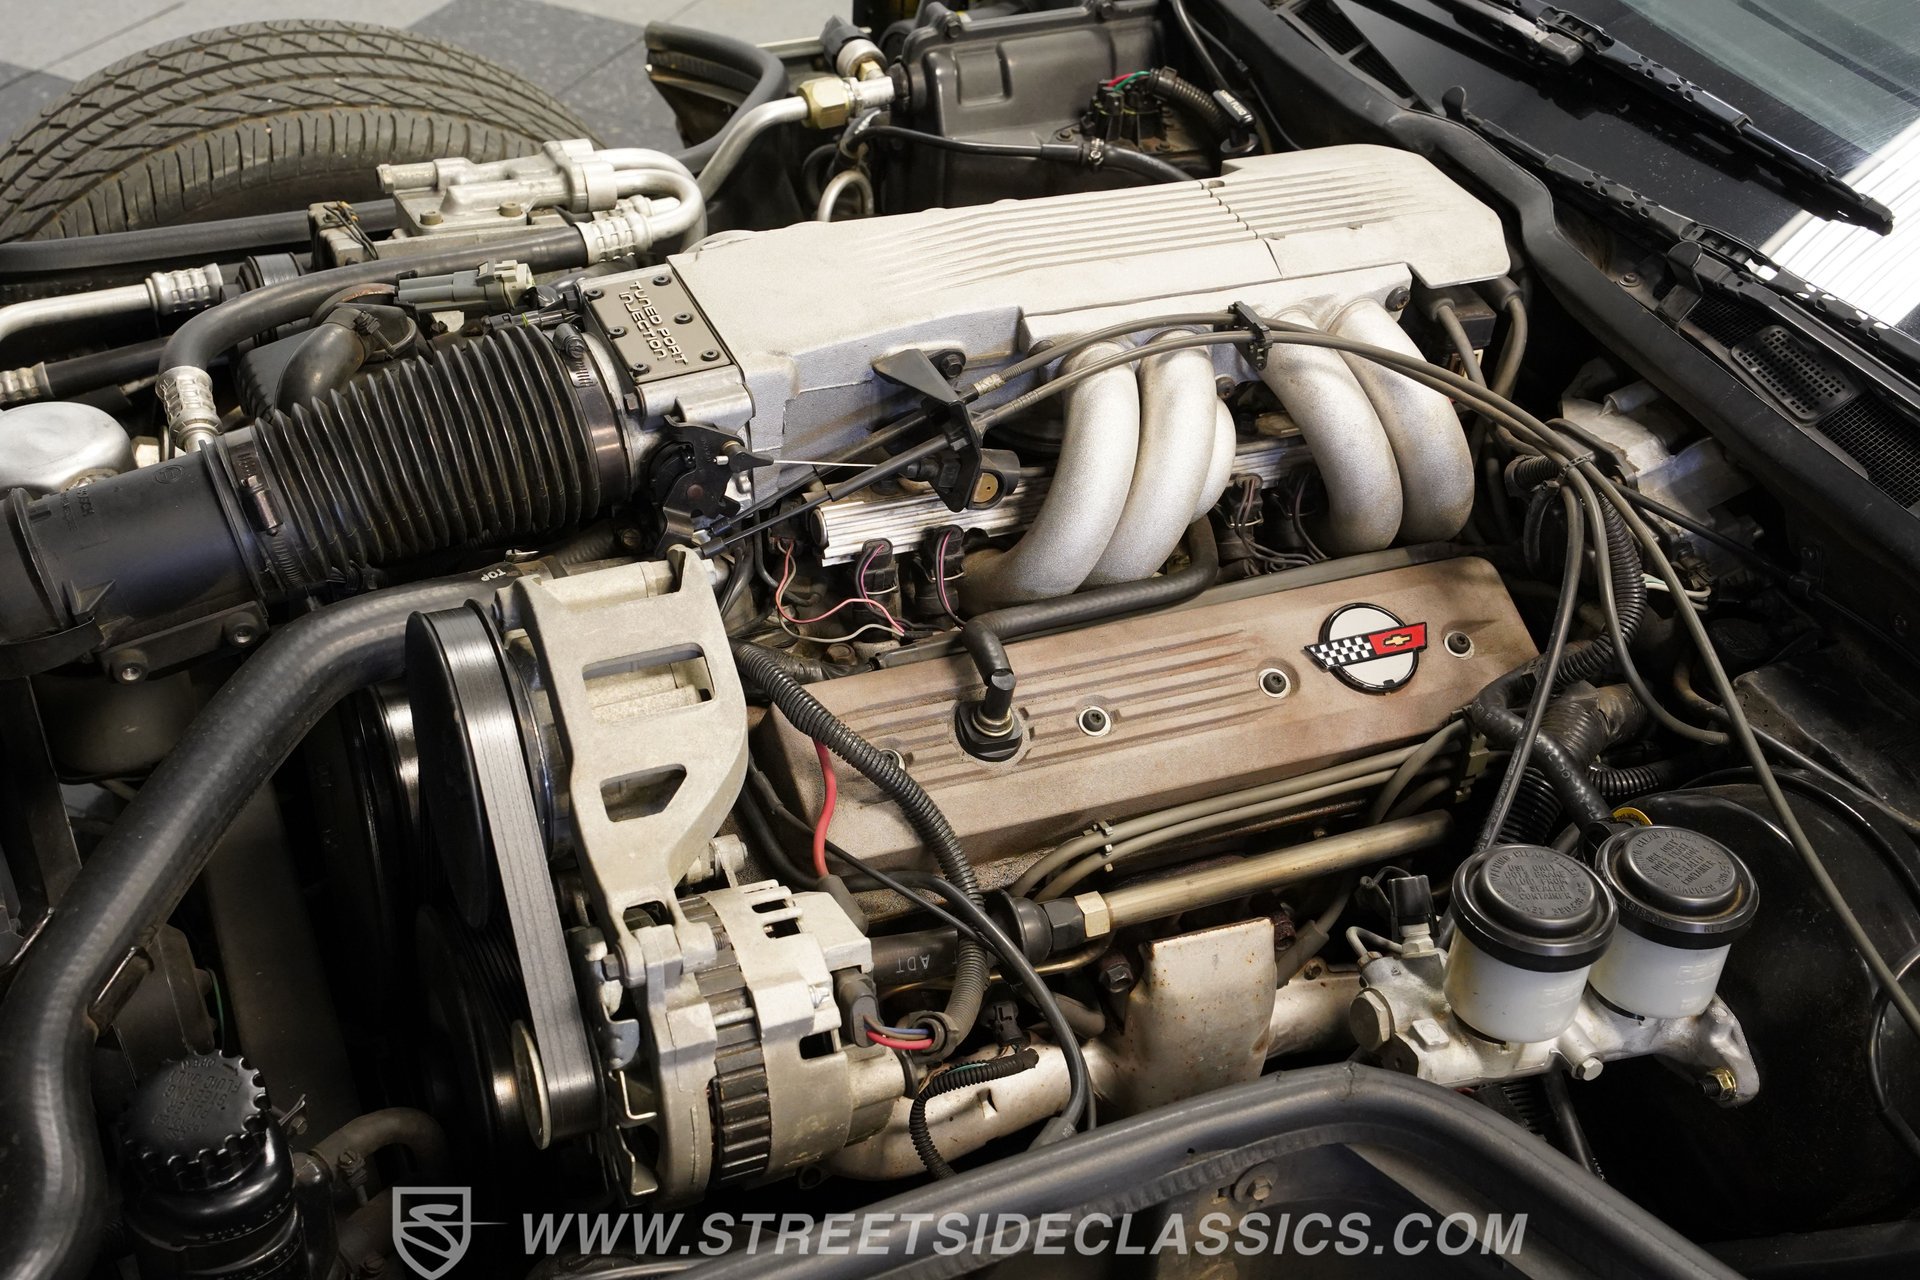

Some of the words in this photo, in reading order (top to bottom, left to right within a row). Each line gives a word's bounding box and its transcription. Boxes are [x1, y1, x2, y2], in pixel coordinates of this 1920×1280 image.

[619, 291, 668, 361] INJECTION
[630, 280, 663, 325] TUNED
[657, 327, 689, 366] PORT
[481, 568, 507, 581] TOP
[896, 954, 930, 973] ADT
